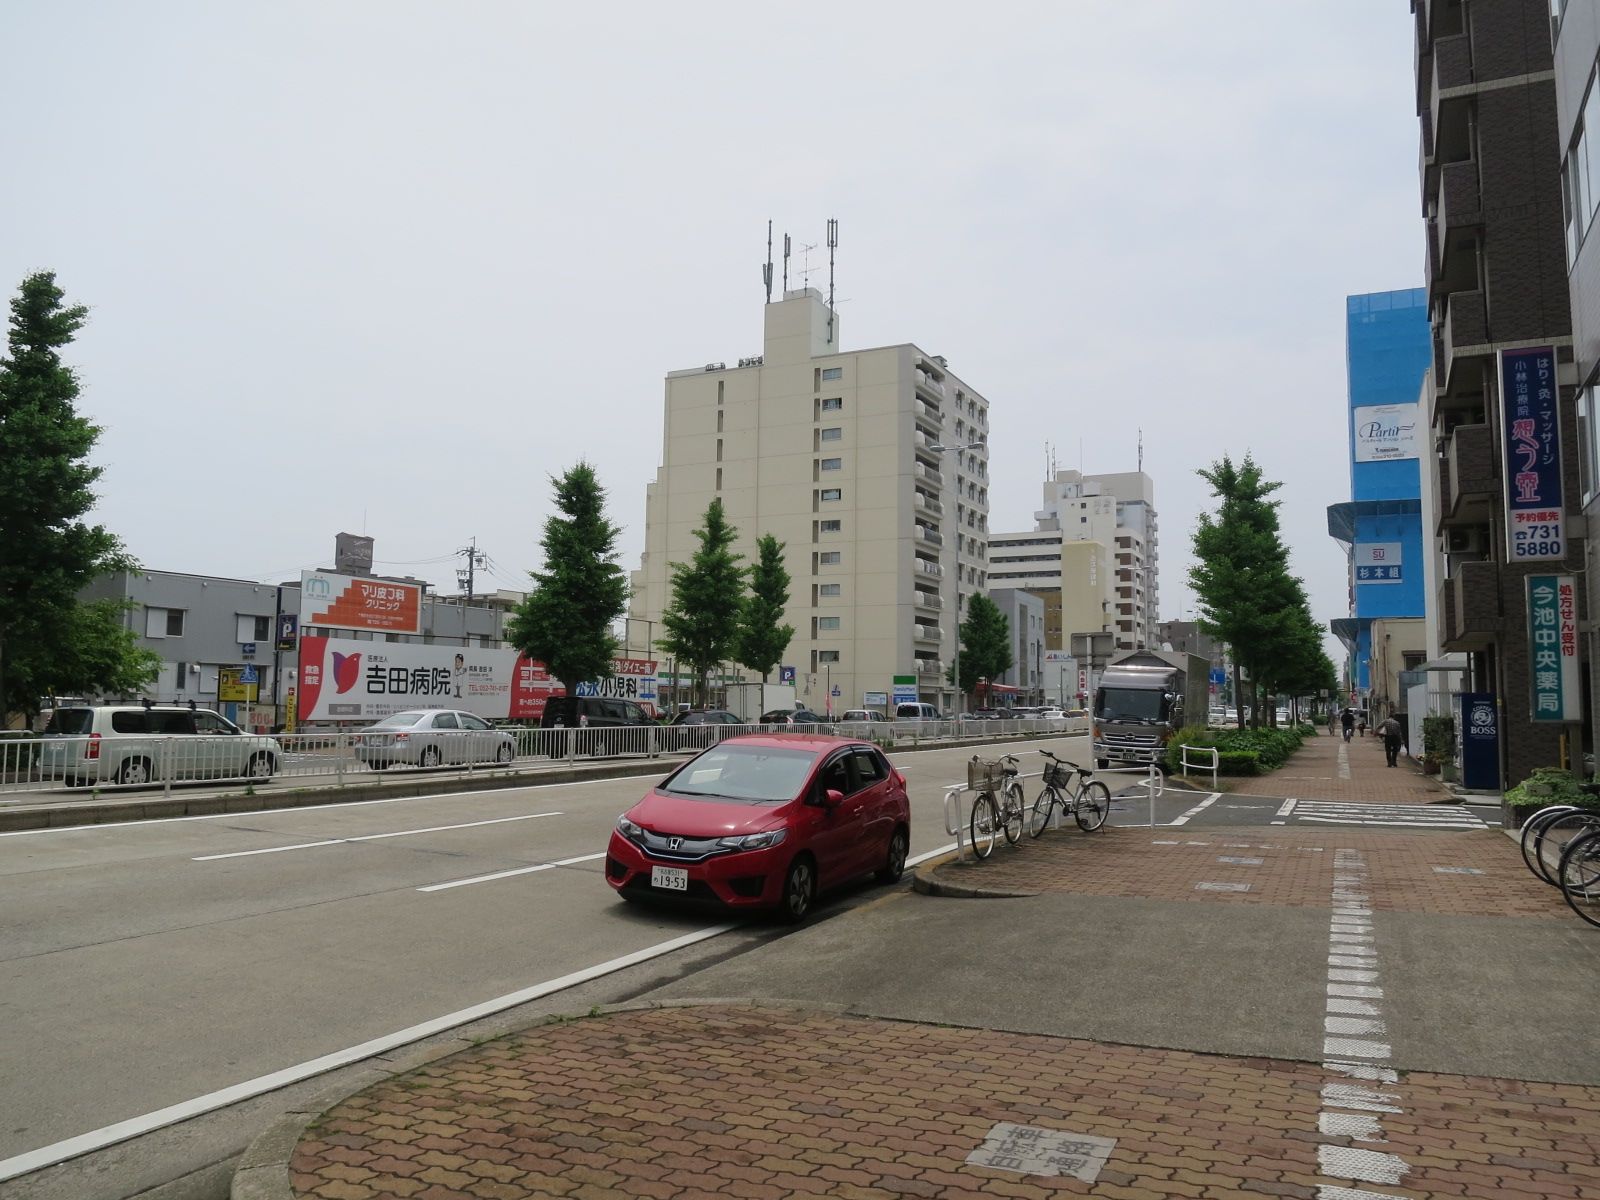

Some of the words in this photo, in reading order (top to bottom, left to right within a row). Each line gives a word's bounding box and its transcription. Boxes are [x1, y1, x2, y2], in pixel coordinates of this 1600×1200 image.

[1514, 361, 1529, 416] 小林治療院
[1537, 358, 1555, 465] はり・灸・マッサージ
[1515, 512, 1559, 523] 予約優先
[1528, 525, 1560, 539] 731
[1516, 541, 1561, 556] 5880
[361, 584, 405, 601] マリ皮フ科
[366, 599, 400, 611] クリニック
[1559, 584, 1575, 657] 処方せん受付
[1533, 585, 1560, 712] 今池中央薬局
[366, 664, 452, 696] 吉田病院
[1470, 726, 1496, 735] BOSS
